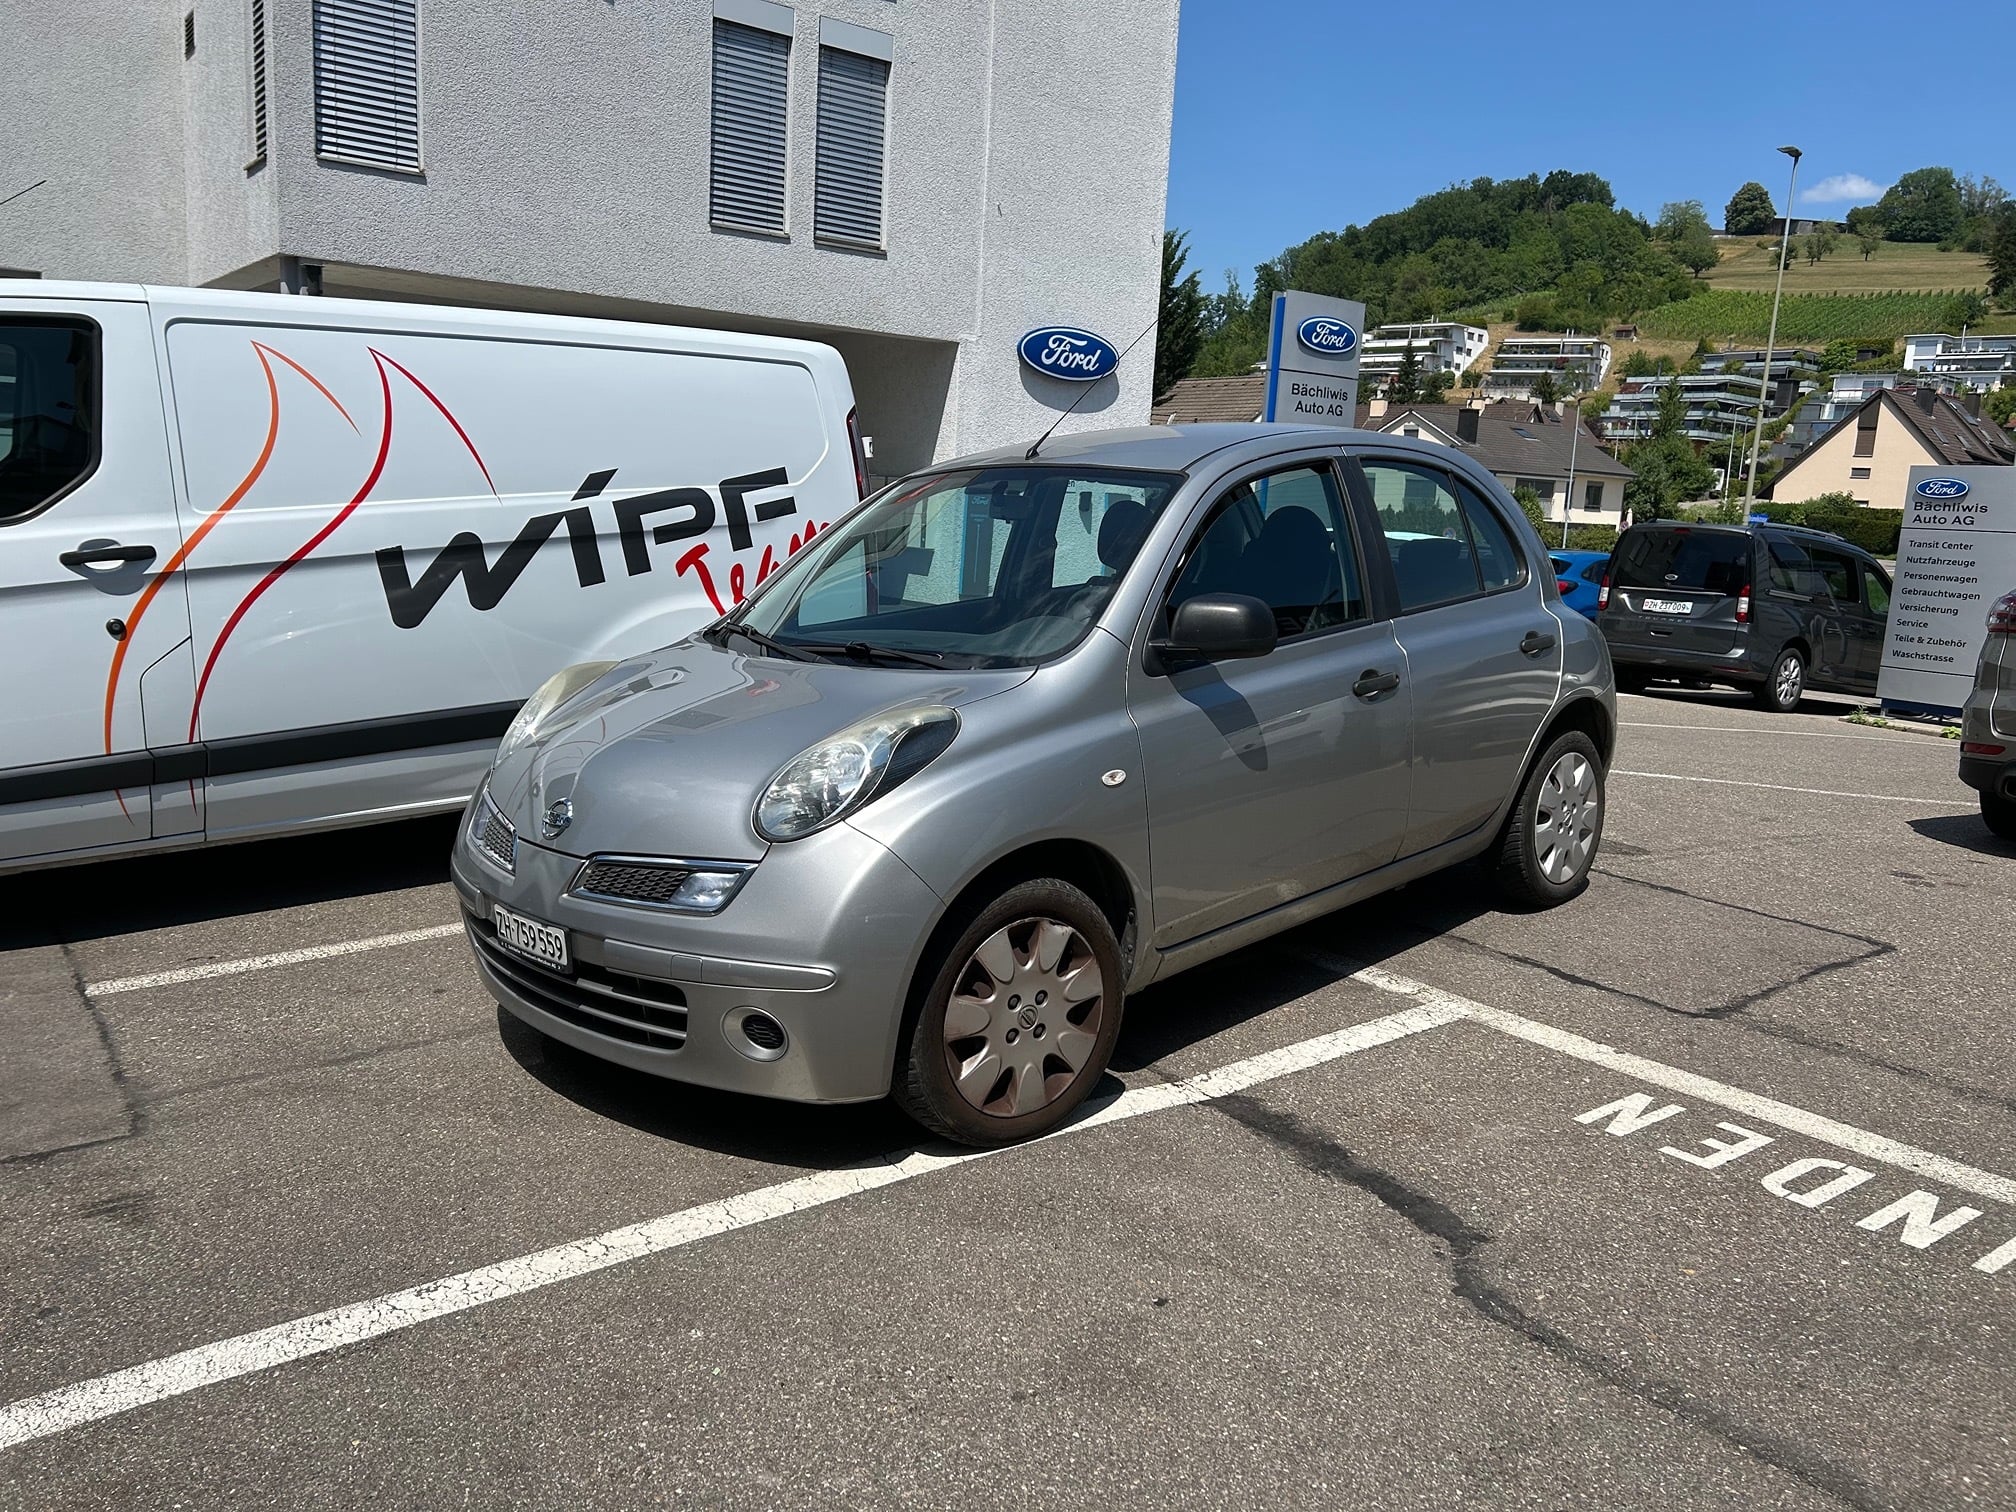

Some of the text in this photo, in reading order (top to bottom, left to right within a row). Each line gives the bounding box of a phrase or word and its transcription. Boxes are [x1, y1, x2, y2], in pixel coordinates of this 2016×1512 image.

[1311, 322, 1348, 348] Ford
[1041, 334, 1102, 371] Ford
[1291, 383, 1348, 401] Bächliwis
[1295, 400, 1343, 417] Auto AG
[1925, 481, 1959, 495] Ford
[1913, 501, 1989, 514] Bächliwis
[1912, 514, 1976, 526] Auto AG
[1909, 540, 1974, 551] Transit Center
[1906, 556, 1976, 568] Nutzfahrzeuge
[1903, 571, 1978, 584] Personenwagen
[1901, 587, 1981, 601] Gebrauchtwagen
[1899, 603, 1959, 616] Versicherung
[1896, 619, 1929, 629] Service
[1894, 633, 1967, 649] Teile & Zubehör
[1892, 649, 1954, 663] Waschstrasse
